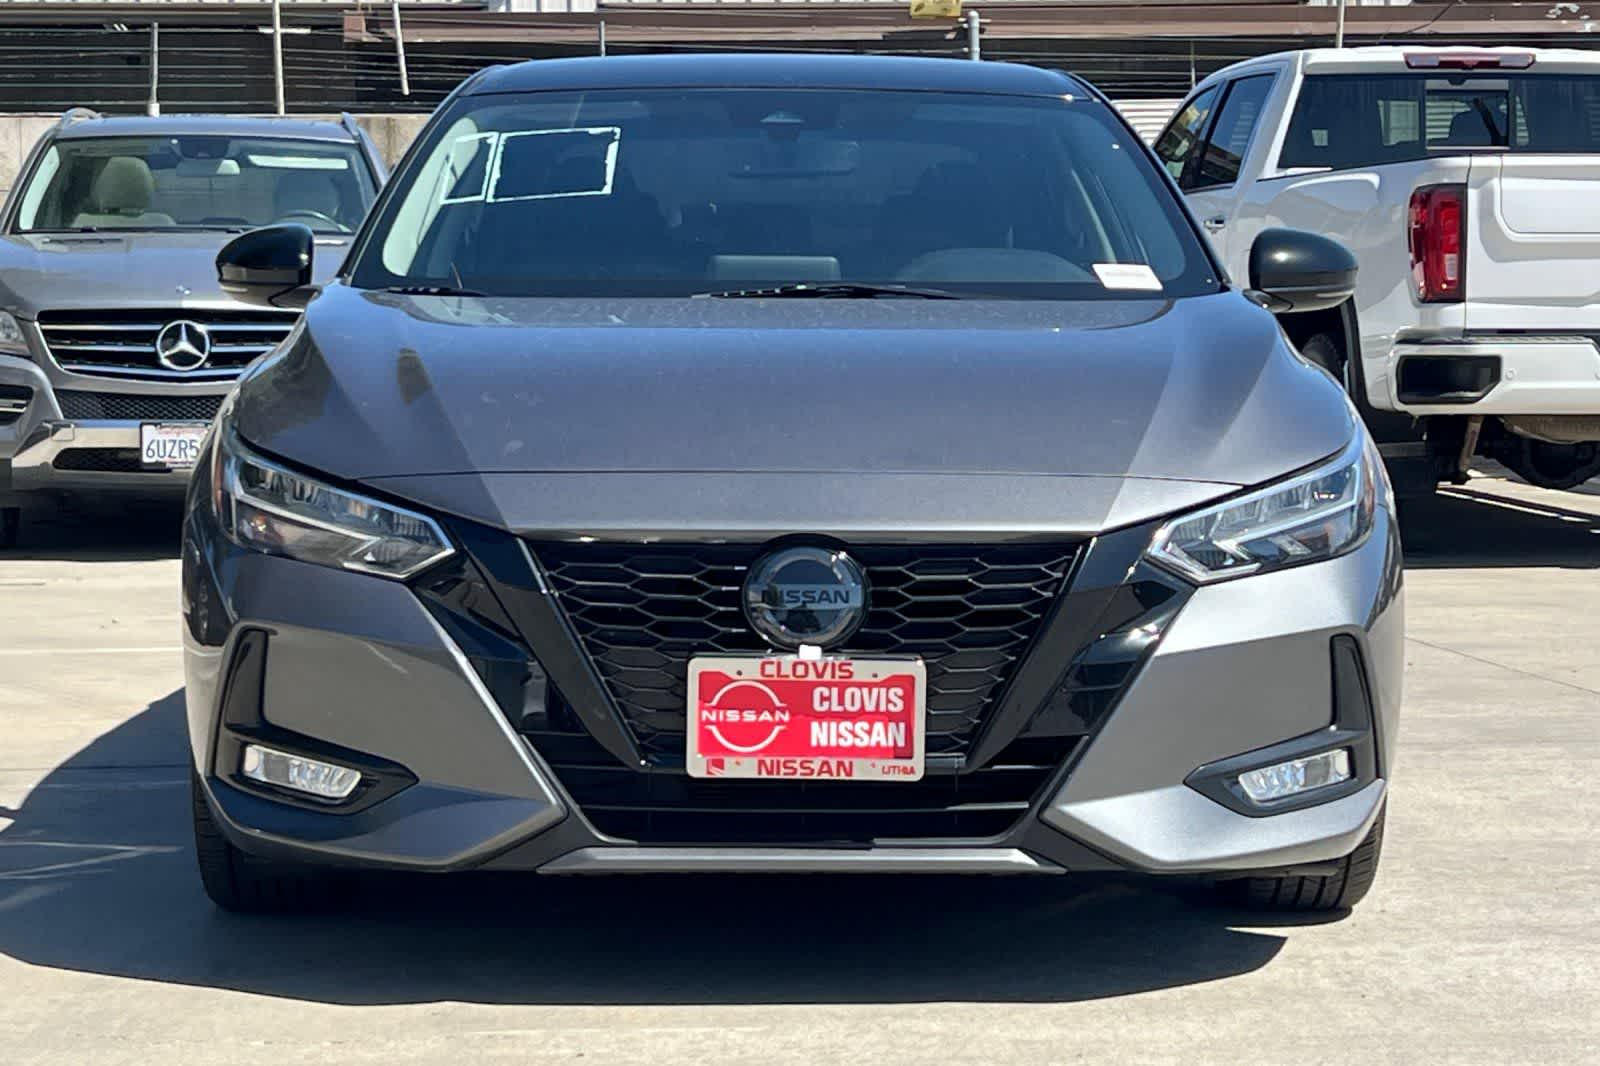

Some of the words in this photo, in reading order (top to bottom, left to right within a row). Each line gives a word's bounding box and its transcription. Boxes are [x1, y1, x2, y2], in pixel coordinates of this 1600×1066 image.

[761, 589, 849, 604] NISSAN
[760, 661, 854, 678] CLOVIS
[812, 687, 904, 712] CLOVIS
[702, 710, 789, 722] NISSAN
[810, 722, 905, 747] NISSAN
[757, 760, 853, 776] NISSAN
